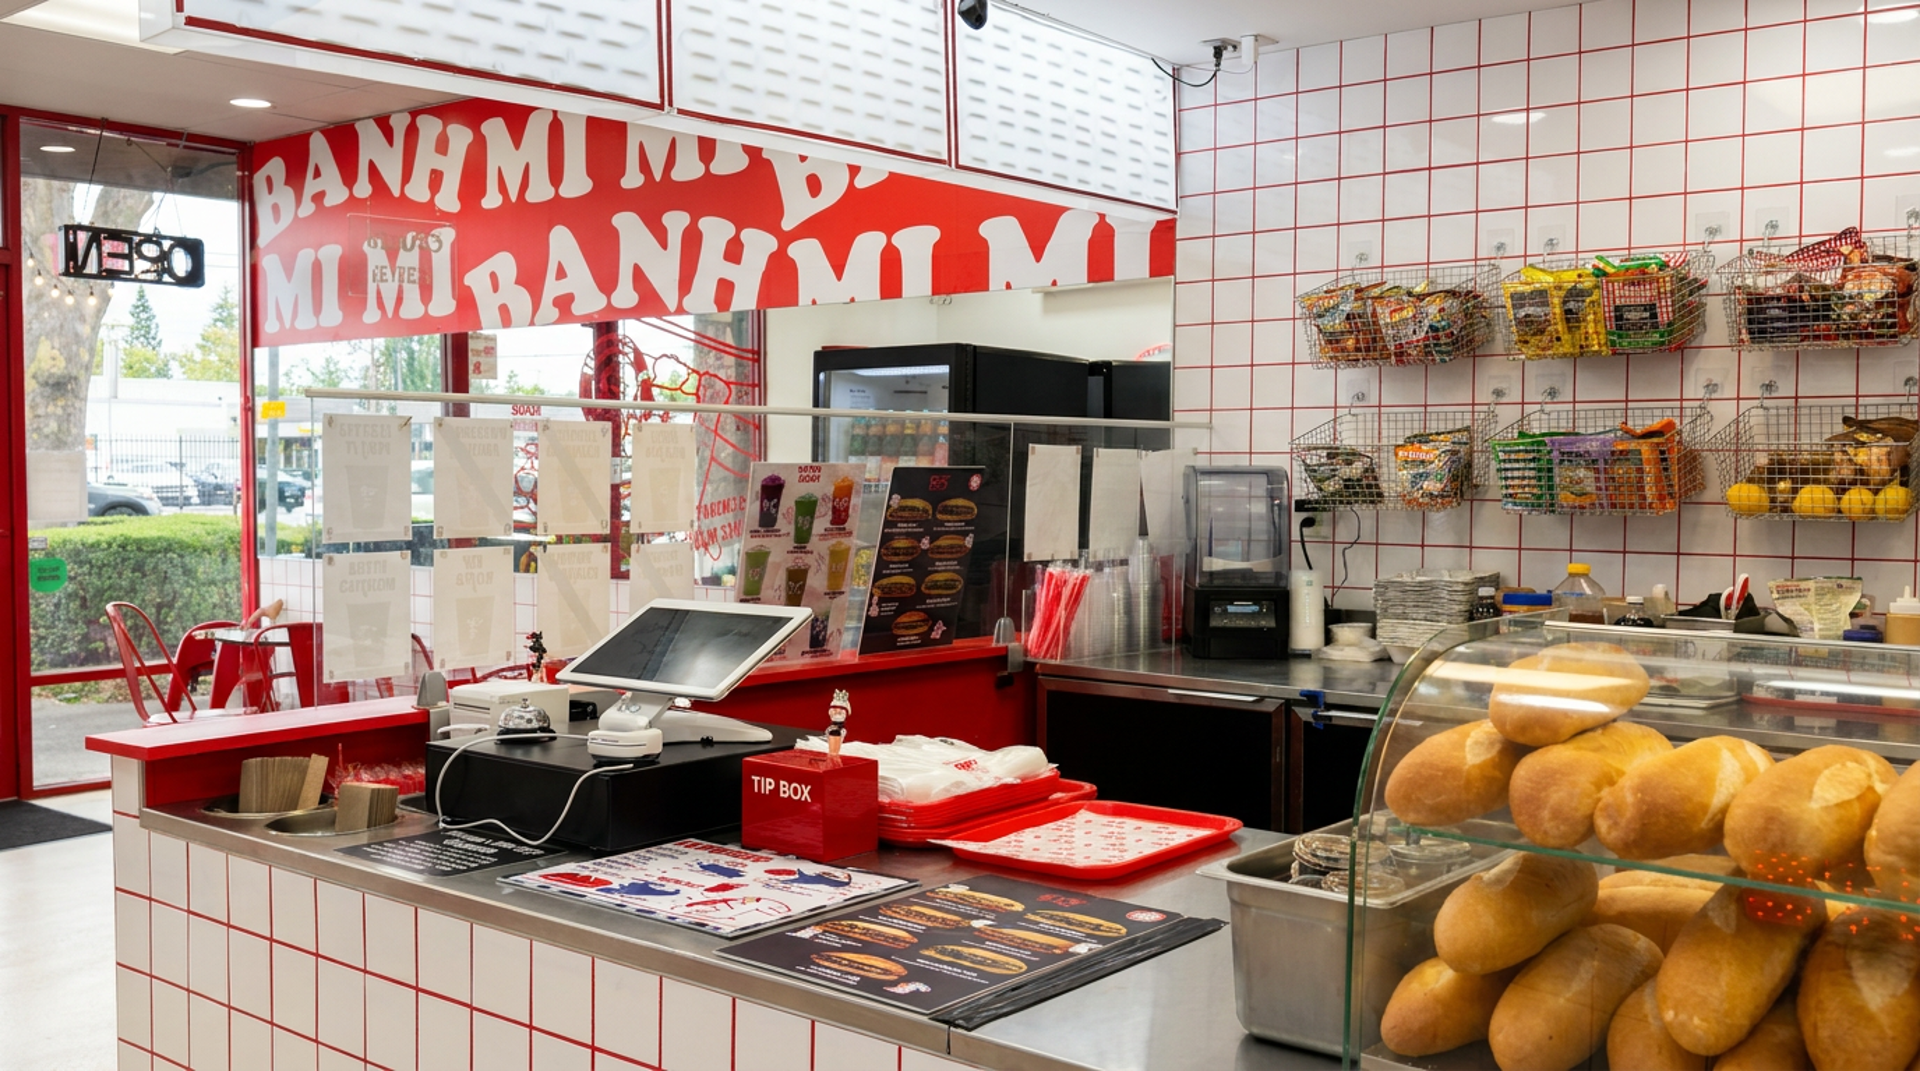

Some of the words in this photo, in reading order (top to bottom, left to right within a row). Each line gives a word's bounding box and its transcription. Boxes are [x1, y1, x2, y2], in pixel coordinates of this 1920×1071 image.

[255, 111, 473, 249] BANH
[480, 108, 594, 210] MI
[263, 244, 344, 334] MI
[362, 226, 457, 324] MI
[464, 209, 778, 329] BANH
[787, 225, 941, 306] MI
[979, 209, 1158, 291] MI
[751, 775, 775, 795] TIP
[779, 780, 812, 803] BOX
